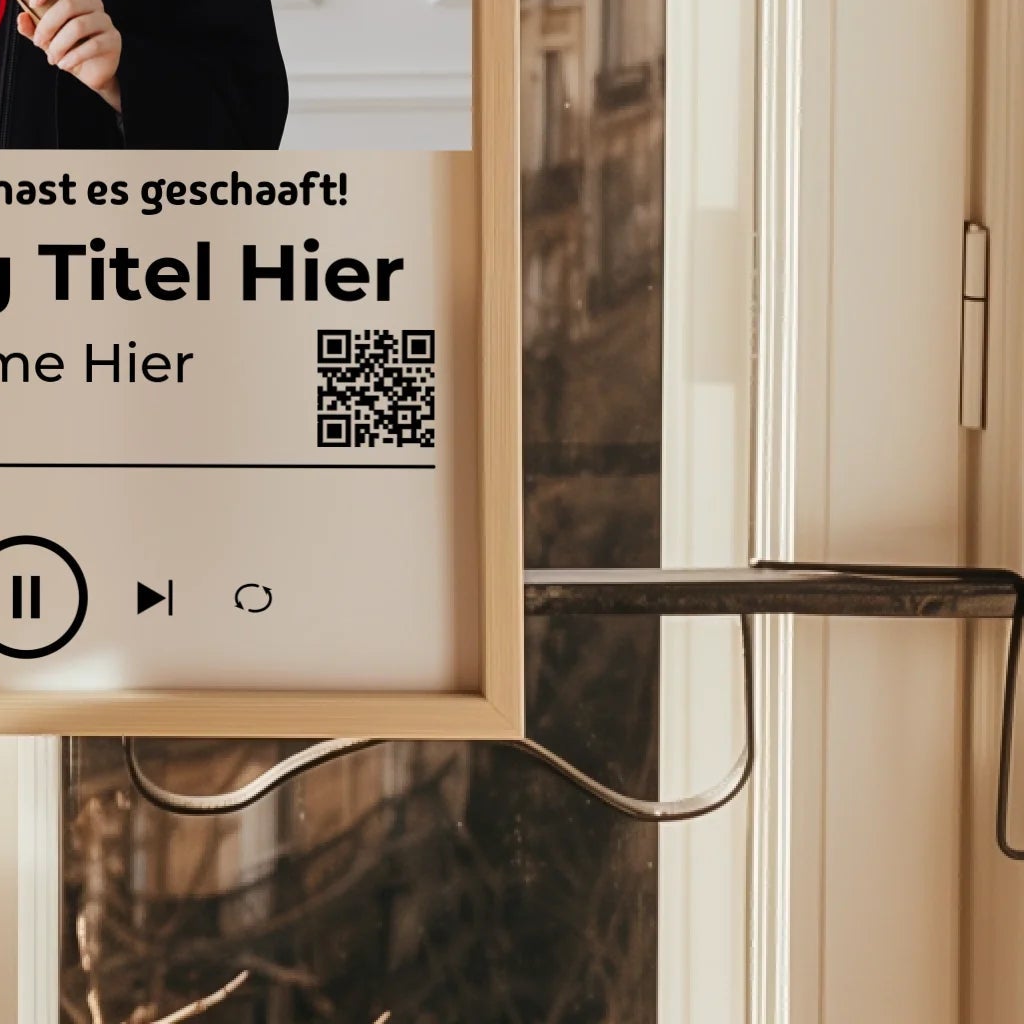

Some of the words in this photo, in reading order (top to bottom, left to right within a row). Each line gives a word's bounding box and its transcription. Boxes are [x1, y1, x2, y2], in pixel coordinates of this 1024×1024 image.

[87, 180, 129, 206] es
[140, 170, 349, 215] geschaaft!
[37, 237, 212, 302] Titel
[242, 237, 405, 303] Hier
[85, 340, 194, 383] Hier
